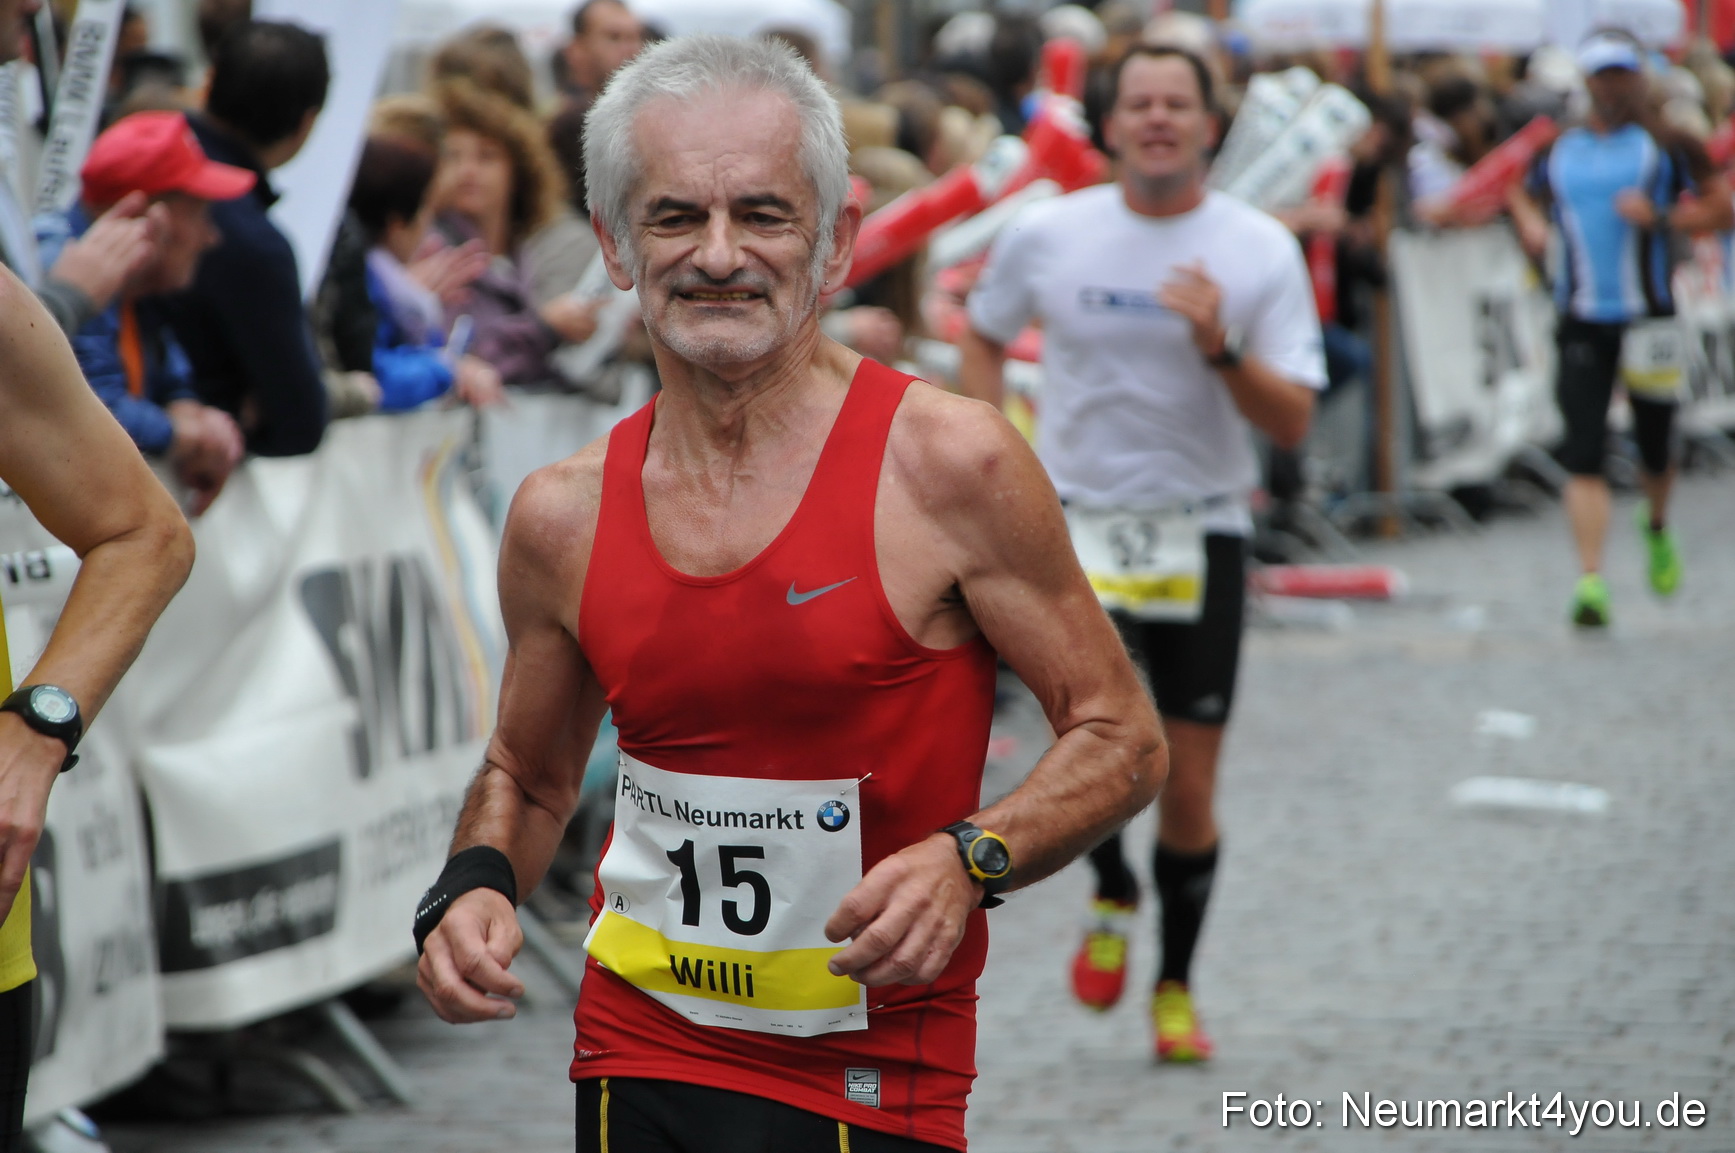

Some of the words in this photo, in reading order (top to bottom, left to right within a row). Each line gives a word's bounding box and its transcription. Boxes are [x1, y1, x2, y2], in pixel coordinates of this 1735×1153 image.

[621, 774, 672, 818] PARTL
[674, 799, 805, 830] Neumarkt
[666, 838, 771, 937] 15
[669, 954, 754, 998] Willi
